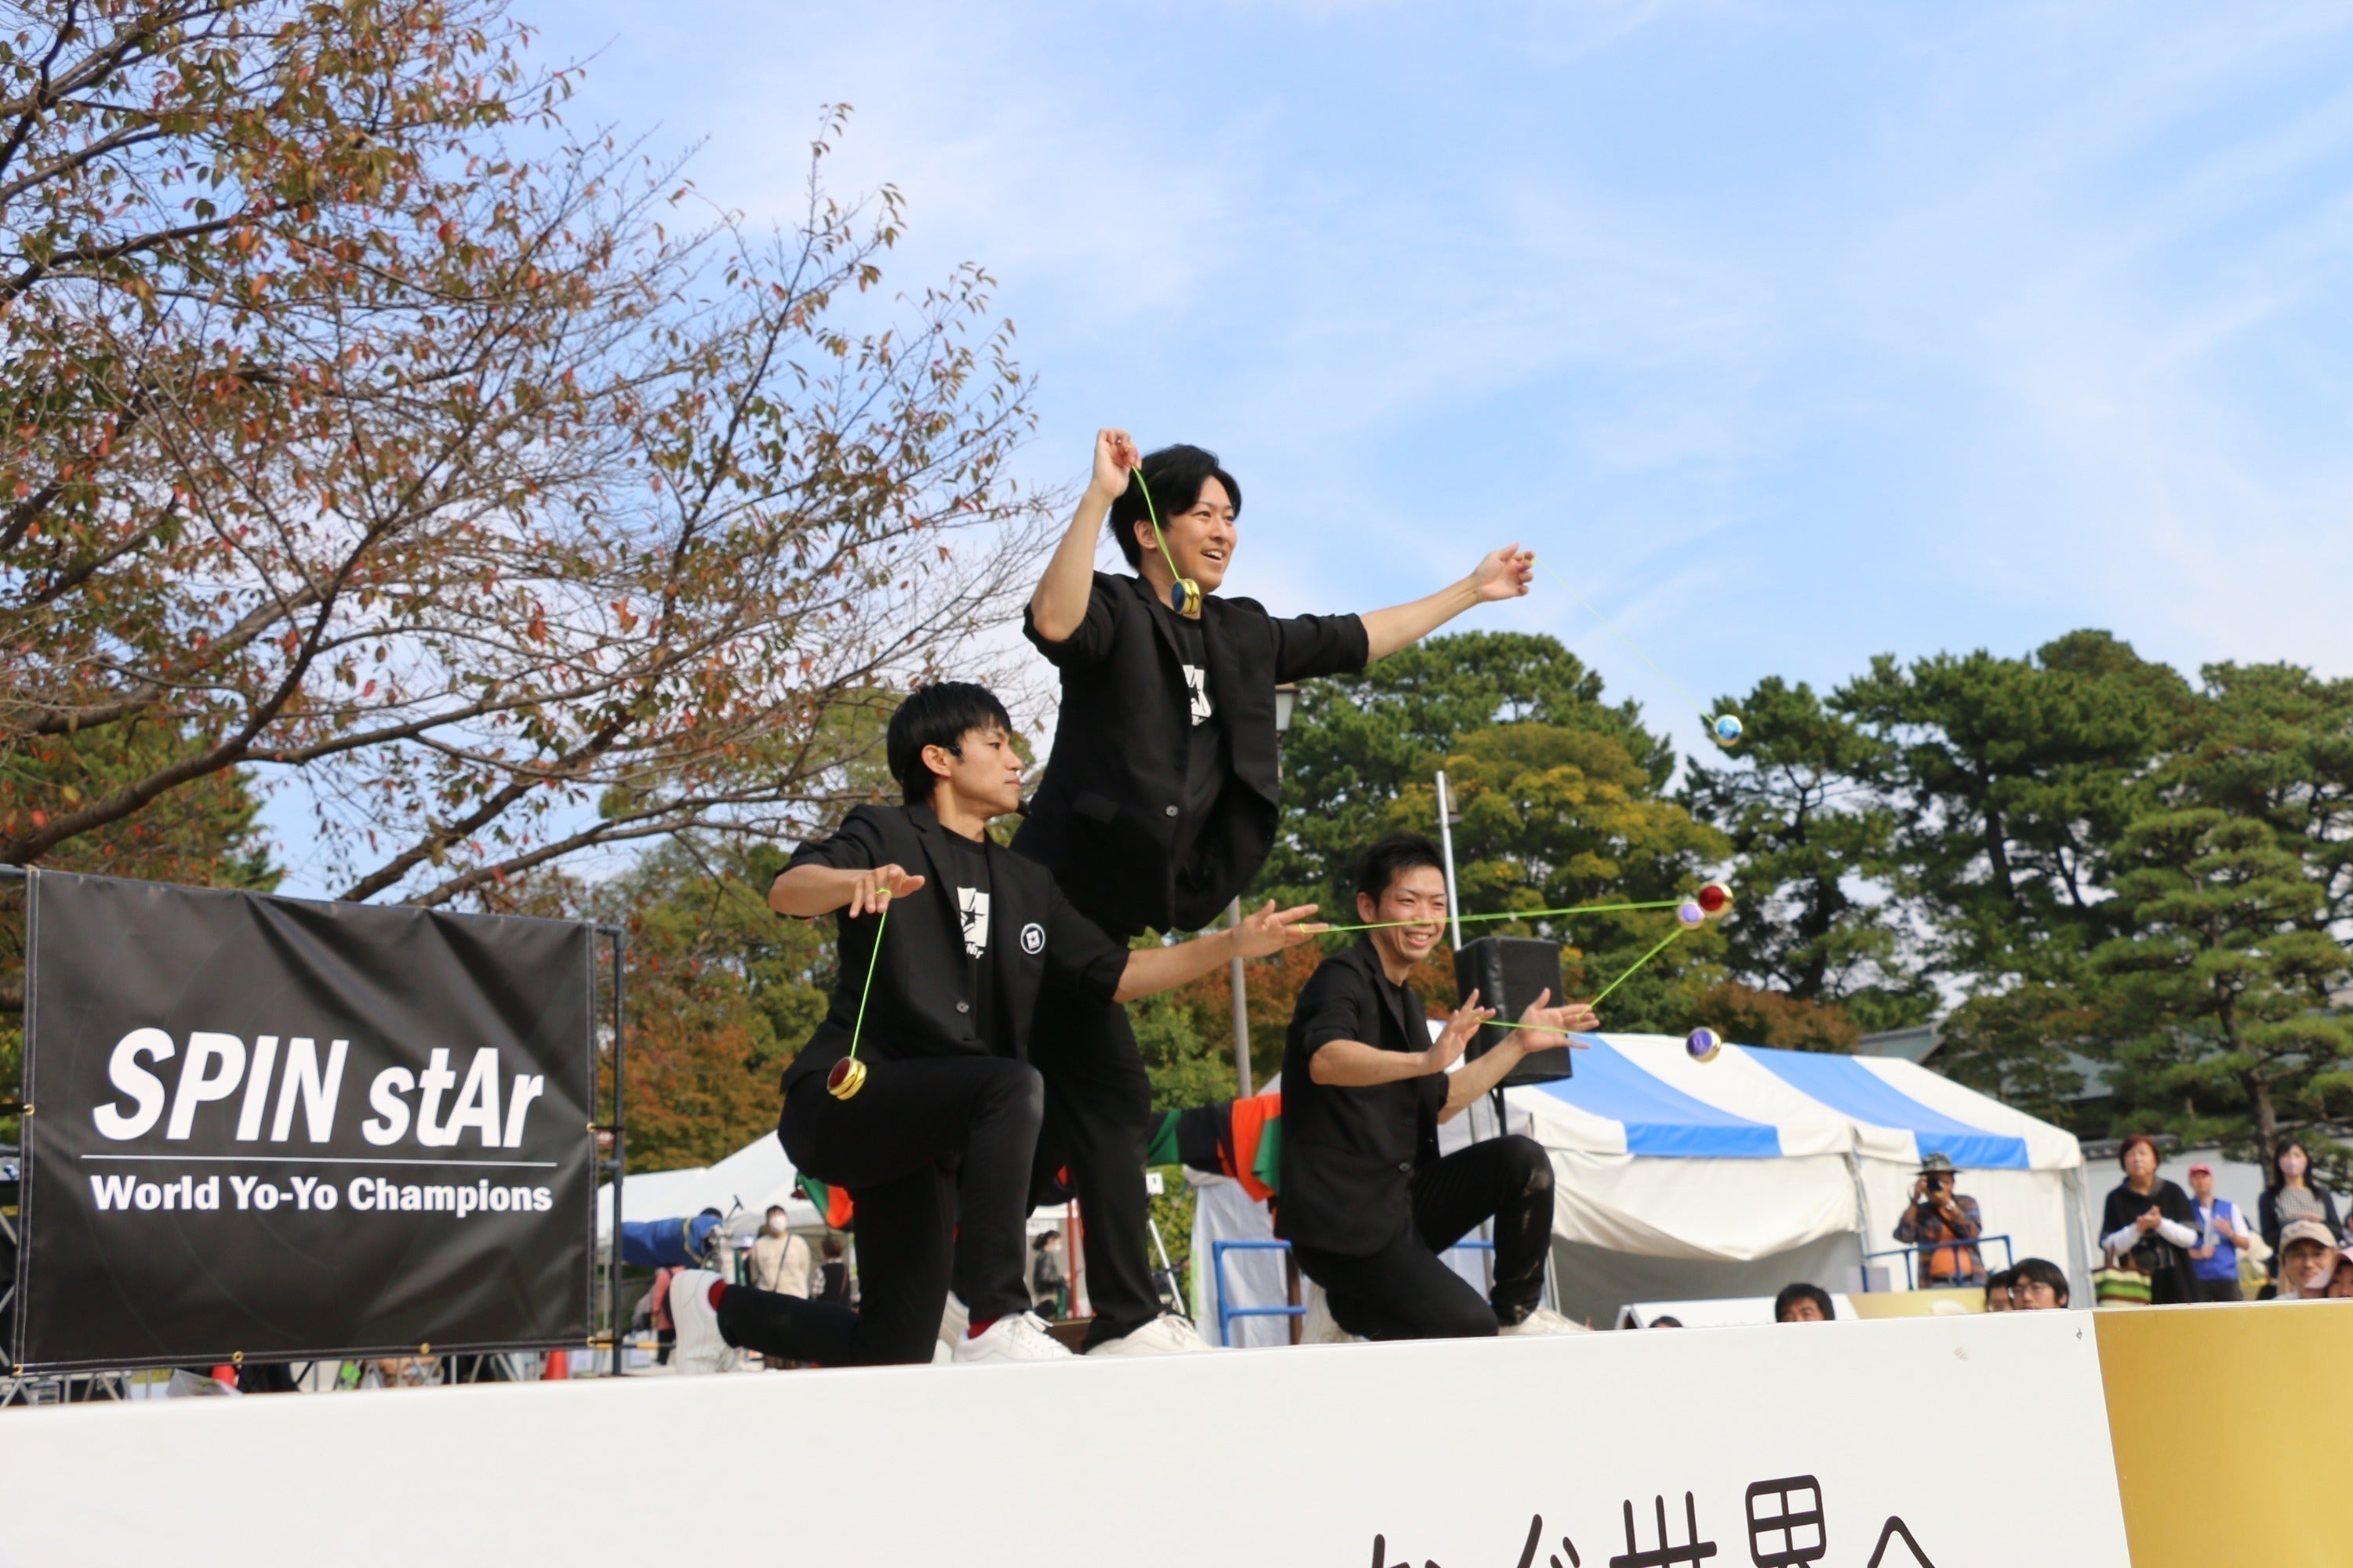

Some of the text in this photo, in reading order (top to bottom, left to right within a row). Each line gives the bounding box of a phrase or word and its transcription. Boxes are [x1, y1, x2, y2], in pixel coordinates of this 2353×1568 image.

[93, 1027, 544, 1148] SPIN stAr
[89, 1175, 553, 1218] World Yo-Yo Champions
